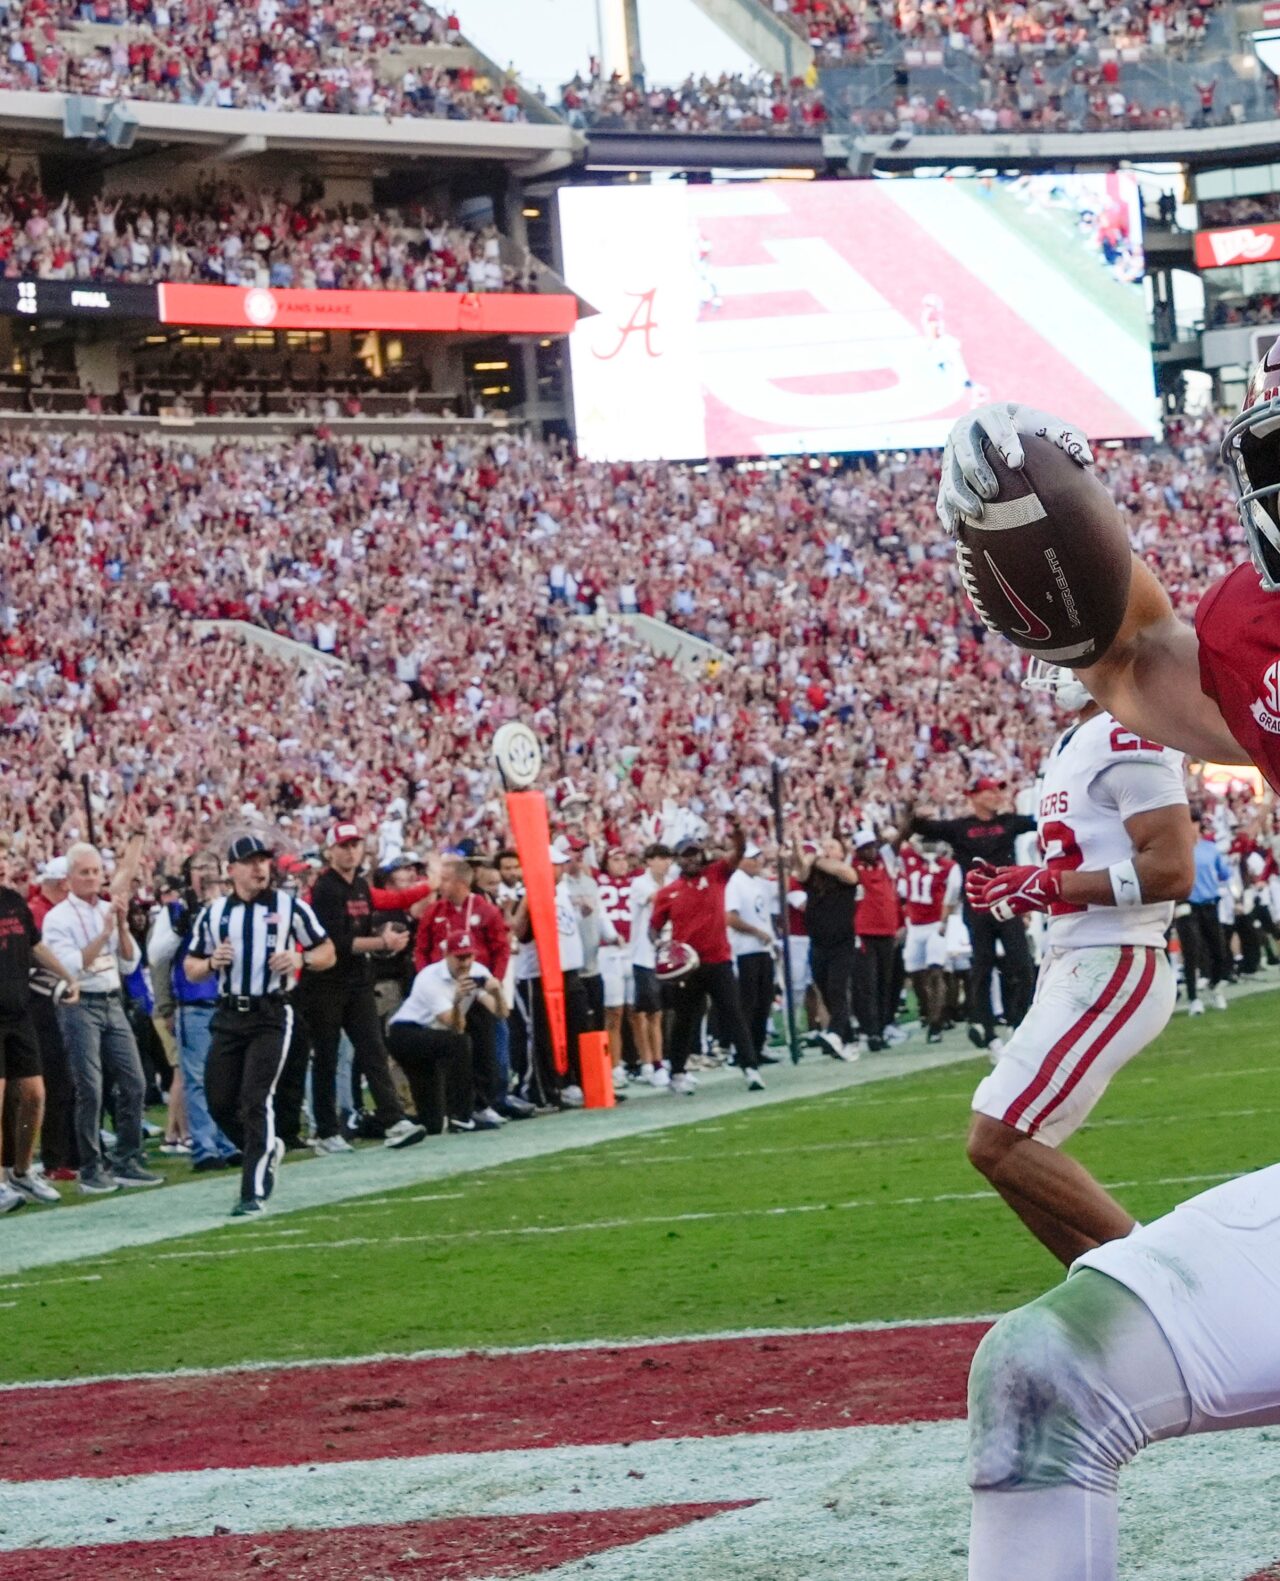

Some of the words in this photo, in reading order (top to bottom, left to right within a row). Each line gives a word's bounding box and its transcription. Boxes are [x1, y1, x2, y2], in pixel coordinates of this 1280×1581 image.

[71, 290, 110, 308] FINAL
[591, 287, 664, 360] A
[1043, 547, 1069, 591] ELITE
[909, 870, 934, 905] 11
